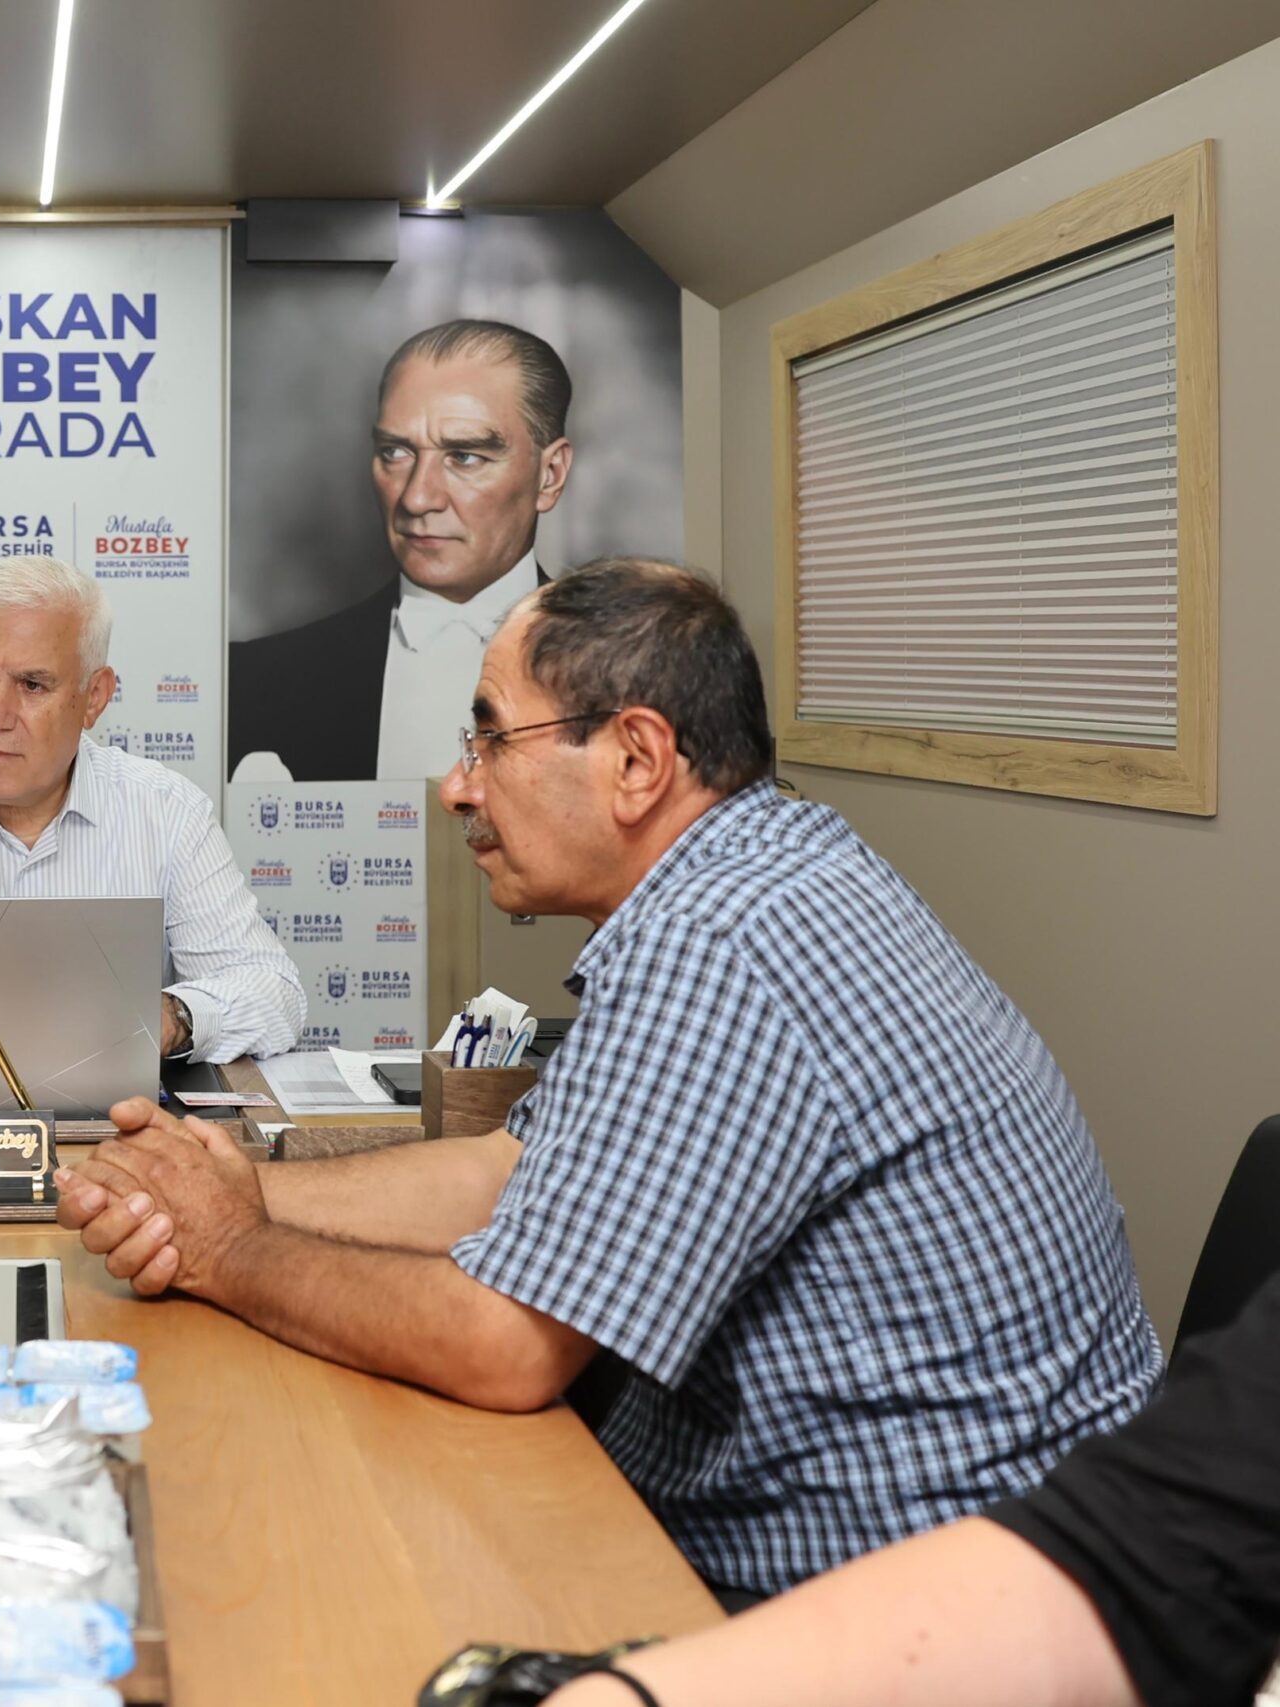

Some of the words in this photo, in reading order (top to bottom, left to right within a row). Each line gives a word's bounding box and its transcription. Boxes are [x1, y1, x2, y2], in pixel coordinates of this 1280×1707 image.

[105, 514, 174, 538] Mustafa
[95, 537, 189, 554] BOZBEY
[95, 560, 127, 568] BURSA
[157, 684, 198, 692] BOZBEY
[144, 733, 195, 743] BURSA
[295, 801, 344, 811] BURSA
[378, 810, 418, 819] BOZBEY
[364, 858, 413, 868] BURSA
[251, 868, 292, 876] BOZBEY
[293, 914, 342, 925] BURSA
[376, 924, 416, 932] BOZBEY
[362, 971, 411, 981] BURSA
[302, 1027, 340, 1037] URSA
[374, 1036, 414, 1045] BOZBEY
